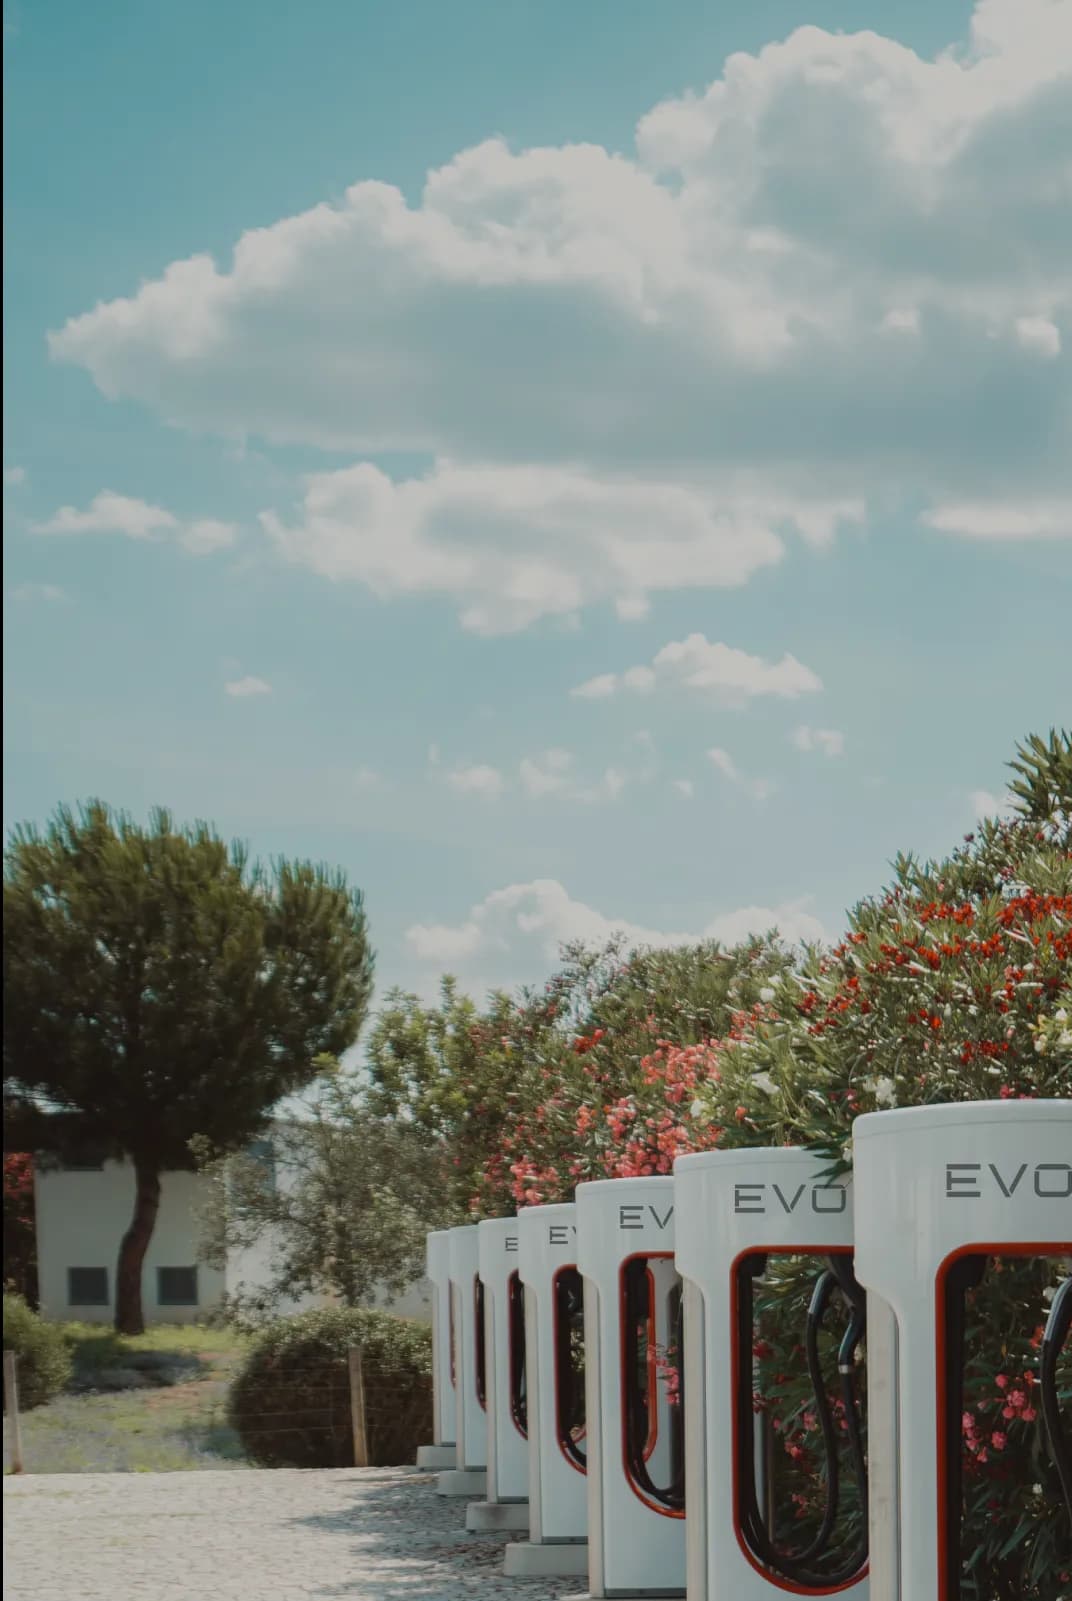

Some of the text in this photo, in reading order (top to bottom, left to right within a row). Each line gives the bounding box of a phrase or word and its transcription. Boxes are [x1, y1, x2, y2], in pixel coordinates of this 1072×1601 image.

[734, 1184, 847, 1213] EVO
[620, 1205, 674, 1229] EV
[549, 1226, 576, 1244] E
